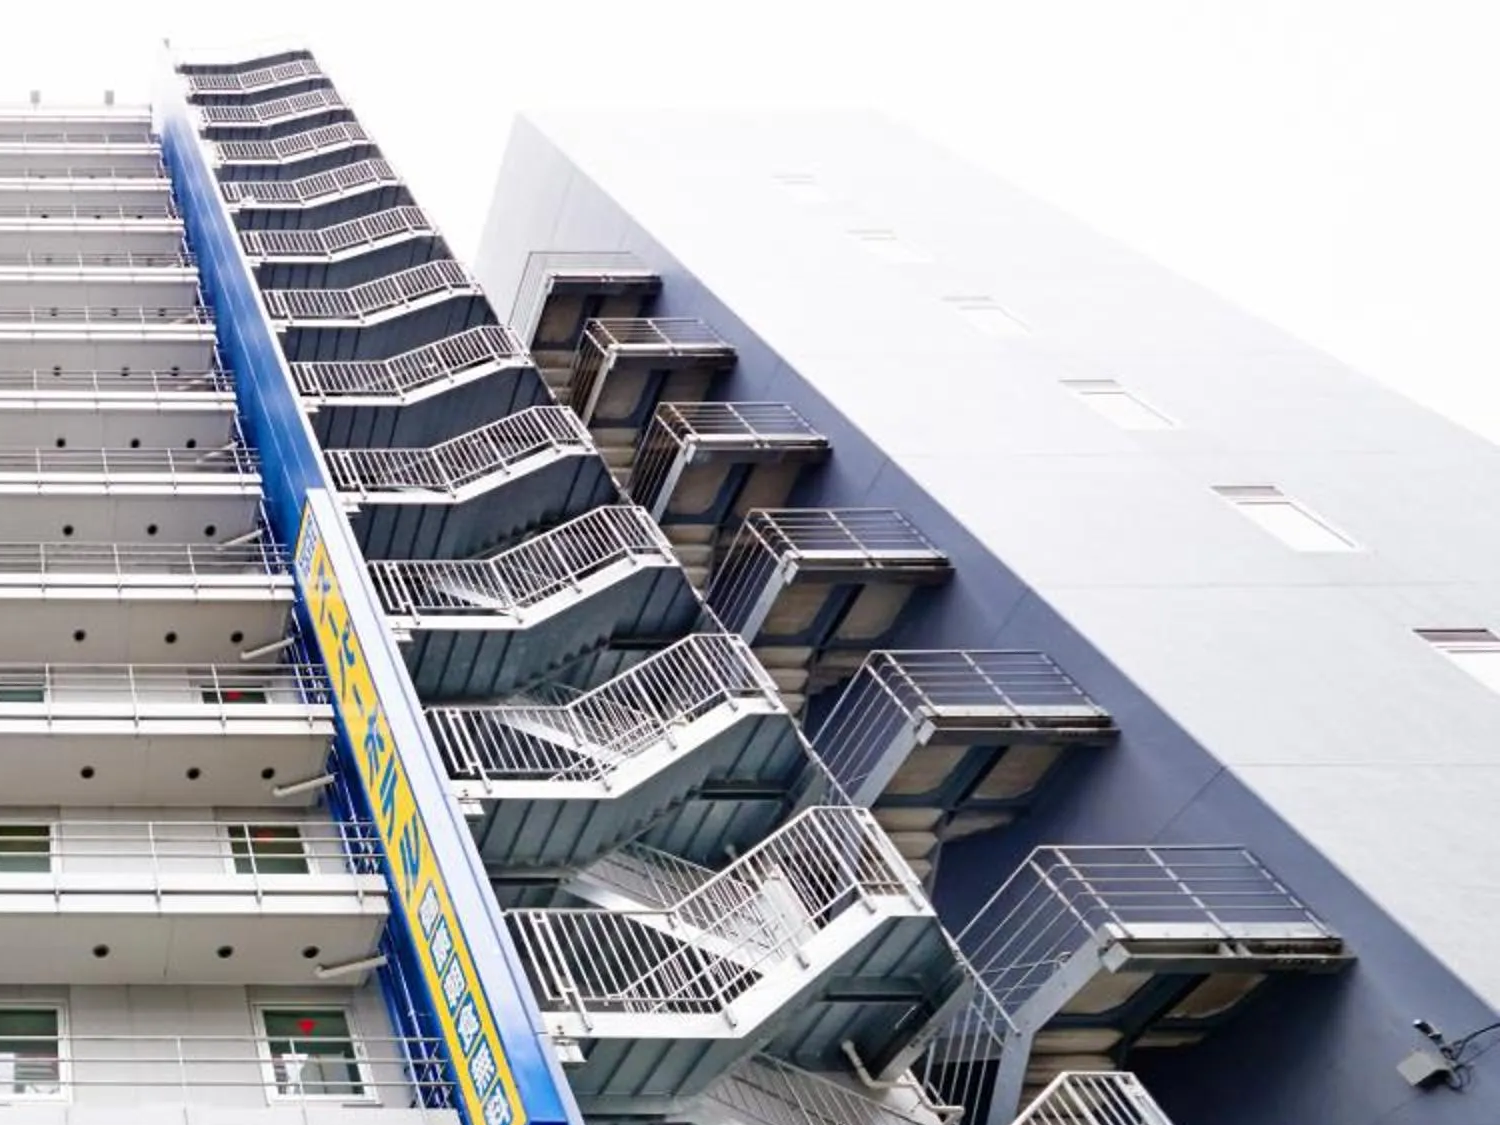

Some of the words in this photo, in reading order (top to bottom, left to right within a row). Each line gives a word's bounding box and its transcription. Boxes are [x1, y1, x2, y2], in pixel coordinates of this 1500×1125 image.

[309, 562, 423, 904] スーパーホテル
